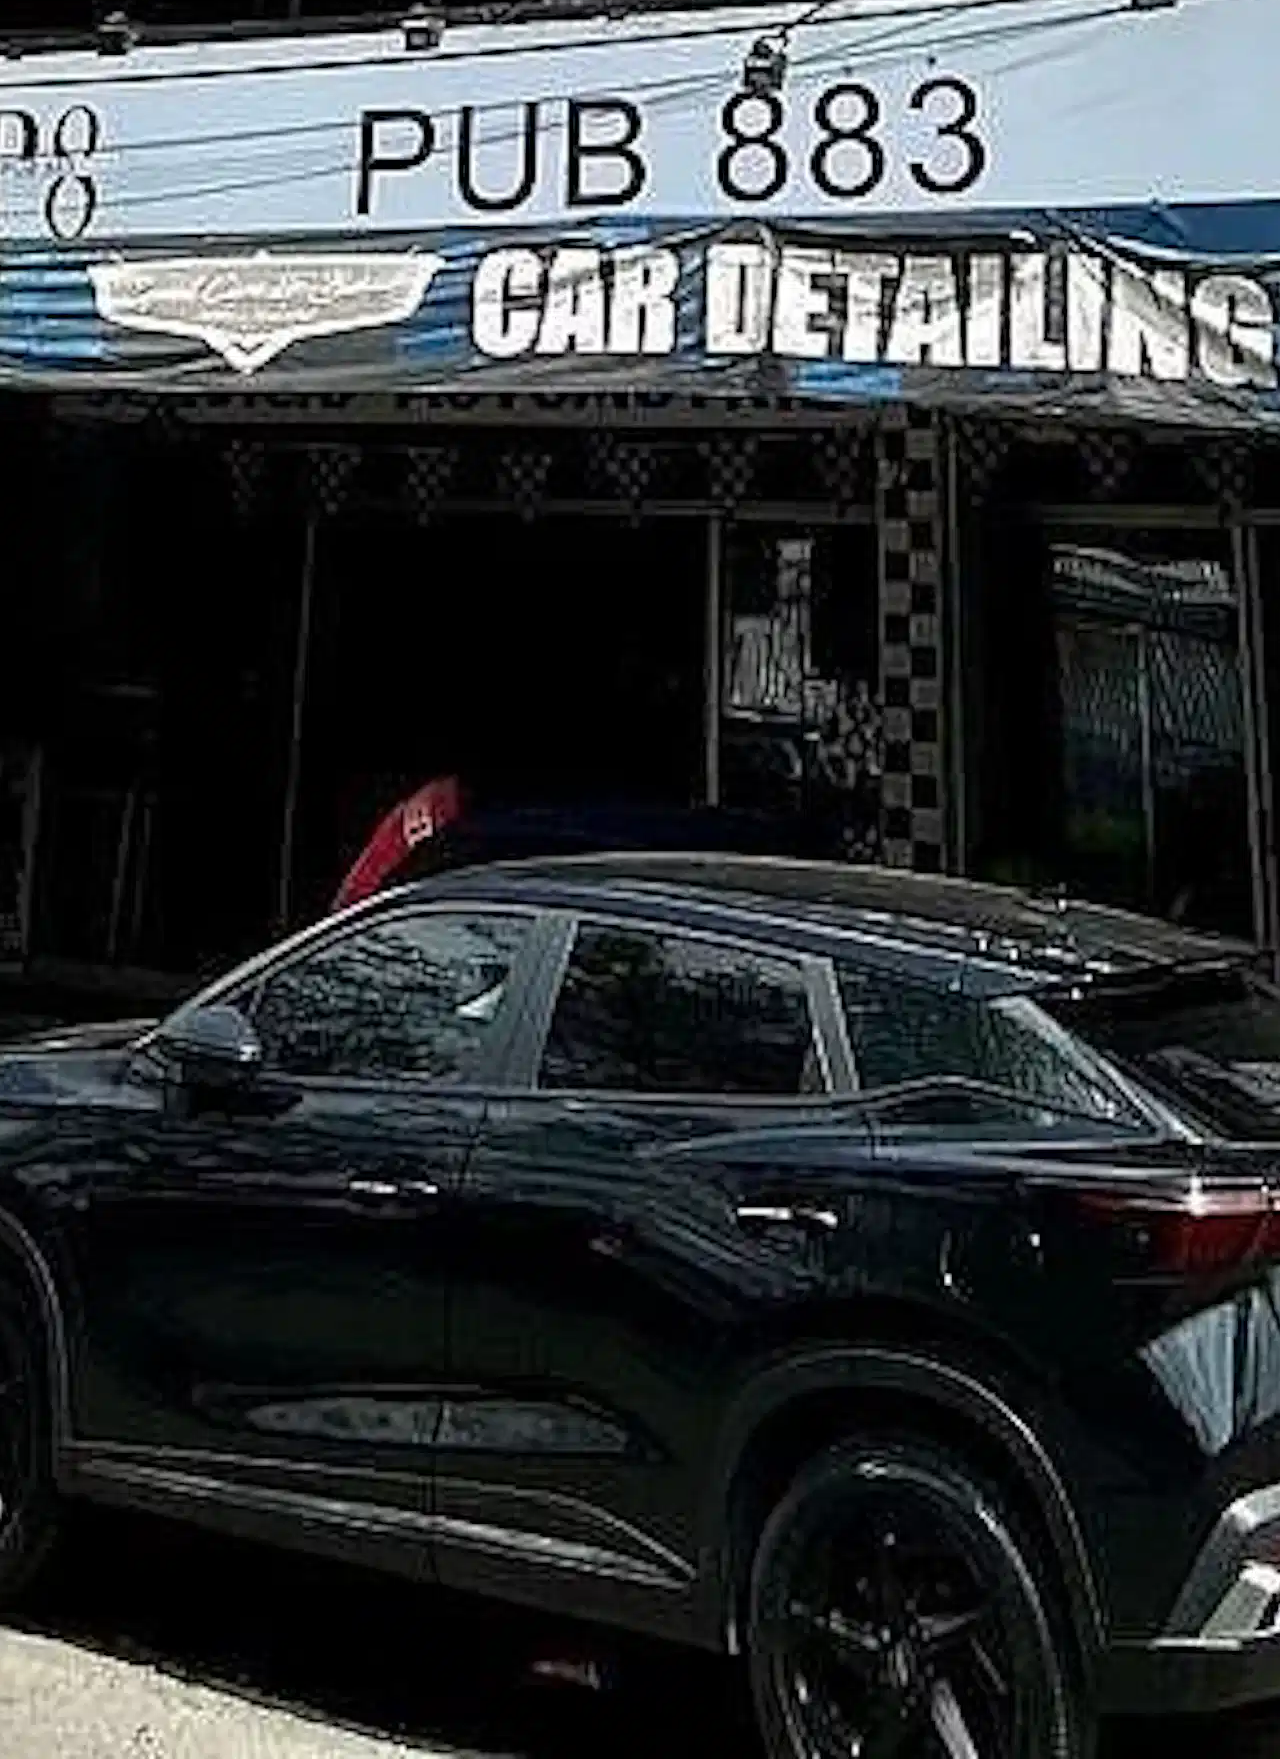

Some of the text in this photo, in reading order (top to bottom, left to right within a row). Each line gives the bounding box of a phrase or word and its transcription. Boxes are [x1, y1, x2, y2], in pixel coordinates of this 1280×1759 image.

[357, 77, 985, 215] PUB 883
[473, 246, 680, 359] CAR
[706, 243, 1278, 389] DETAILING
